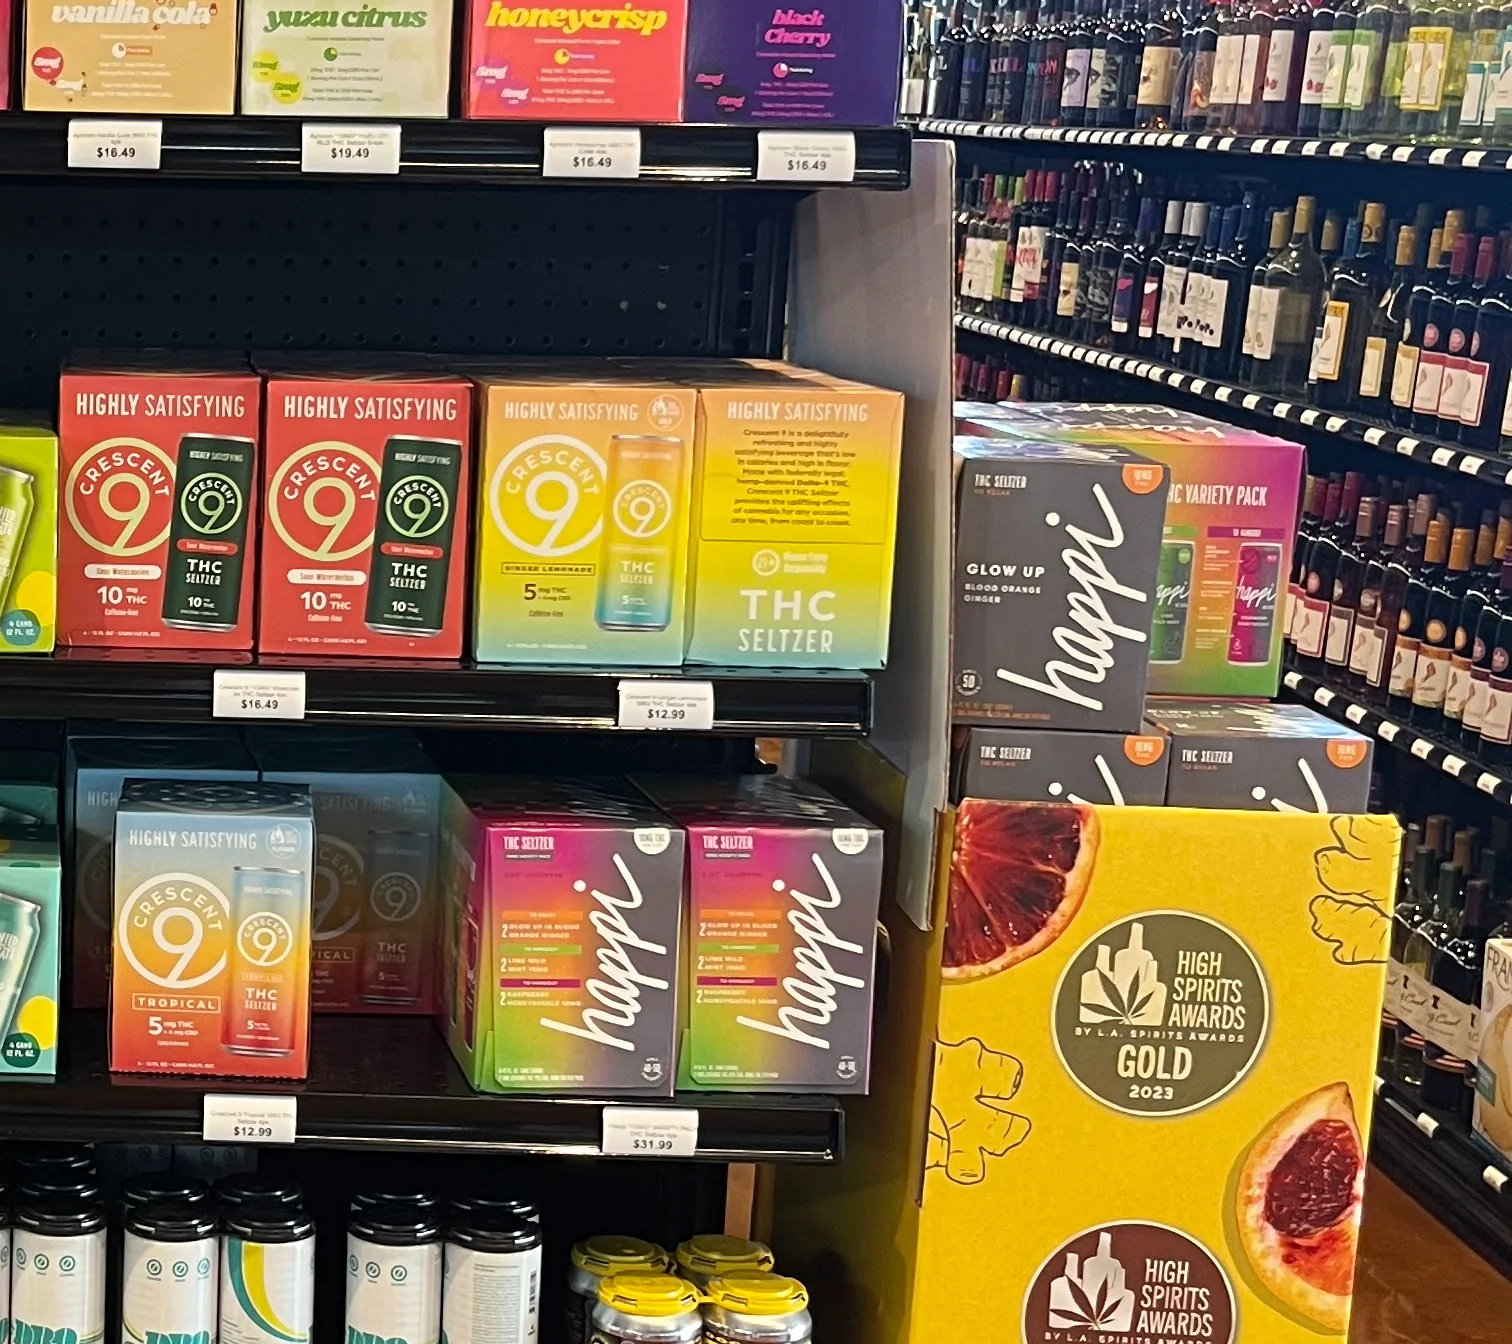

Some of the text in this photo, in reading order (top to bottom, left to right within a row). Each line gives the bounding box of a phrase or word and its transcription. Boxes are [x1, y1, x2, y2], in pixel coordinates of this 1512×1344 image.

[51, 0, 213, 25] vanilla cola
[263, 3, 427, 33] yuzu citrus
[485, 0, 667, 35] honeycrisp
[772, 9, 824, 27] black
[764, 28, 831, 48] Cherry
[572, 156, 612, 169] $16.49
[76, 393, 245, 417] HIGHLY SATISFYING
[79, 452, 170, 497] CRESCENT
[974, 473, 1027, 488] THC SELTZER
[1185, 486, 1267, 506] VARIETY PACK
[186, 559, 222, 574] THC
[967, 564, 1045, 578] GLOW UP
[185, 572, 221, 585] SELTZER
[740, 589, 836, 622] THC
[996, 483, 1147, 711] happi
[738, 628, 834, 653] SELTZER
[241, 699, 278, 710] $16.49
[647, 708, 685, 720] $12.99
[1177, 951, 1222, 976] HIGH
[1173, 976, 1243, 1004] SPIRITS
[138, 997, 216, 1010] TROPICAL
[1169, 1003, 1246, 1030] AWARDS
[1075, 1027, 1091, 1035] BY
[1130, 1030, 1182, 1040] SPIRITS
[1189, 1033, 1244, 1042] AWARDS
[1117, 1045, 1192, 1080] GOLD
[1129, 1084, 1174, 1100] 2023
[633, 1139, 672, 1150] $31.99
